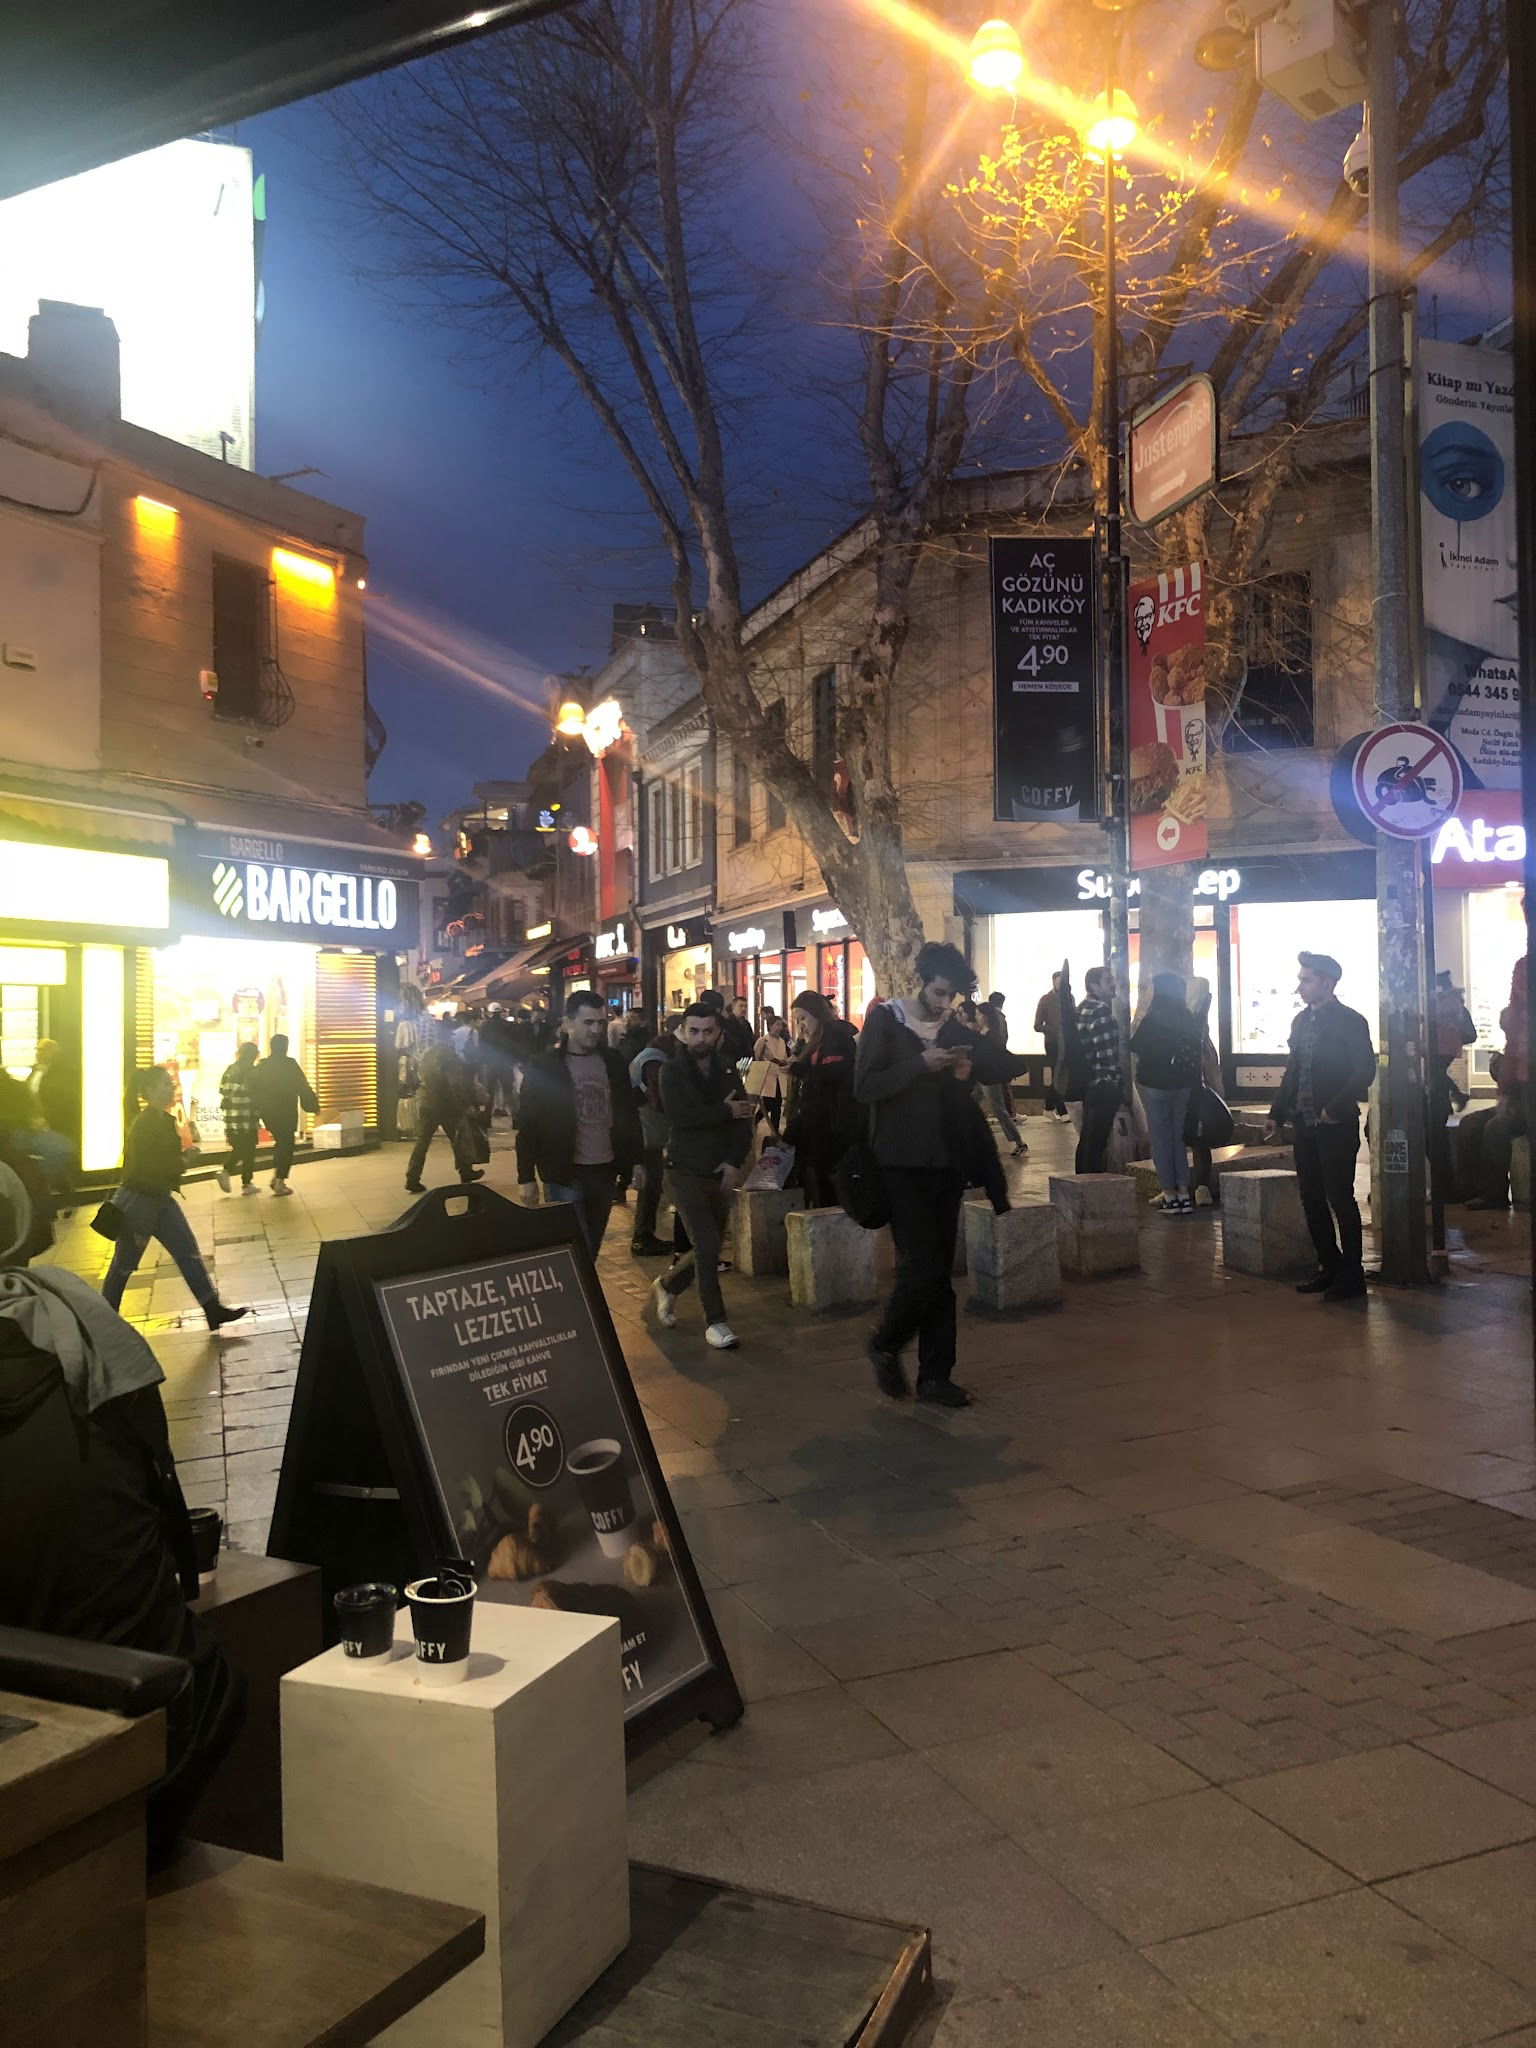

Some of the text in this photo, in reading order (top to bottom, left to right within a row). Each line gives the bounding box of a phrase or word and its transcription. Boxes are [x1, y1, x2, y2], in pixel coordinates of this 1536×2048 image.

[1427, 372, 1462, 393] Kitap
[1029, 552, 1056, 573] AÇ
[1474, 555, 1499, 566] Adam
[1002, 573, 1084, 593] GÖZÜNÜ
[1002, 594, 1086, 614] KADIKÖY
[1156, 593, 1201, 628] KFC
[1016, 644, 1069, 677] 4.90
[1485, 685, 1508, 701] 345
[1185, 764, 1203, 776] KFC
[1020, 784, 1073, 807] COFFY
[229, 836, 284, 862] BARGELLO
[246, 864, 397, 930] BARGELLO
[406, 1266, 564, 1322] TAPTAZE, HIZLI,
[454, 1297, 543, 1346] LEZZETLİ
[430, 1361, 471, 1379] FIRINDAN
[525, 1351, 552, 1366] KAHVE
[482, 1370, 549, 1402] TEK FİYAT
[516, 1424, 554, 1471] 4.90
[590, 1506, 625, 1531] COFFY
